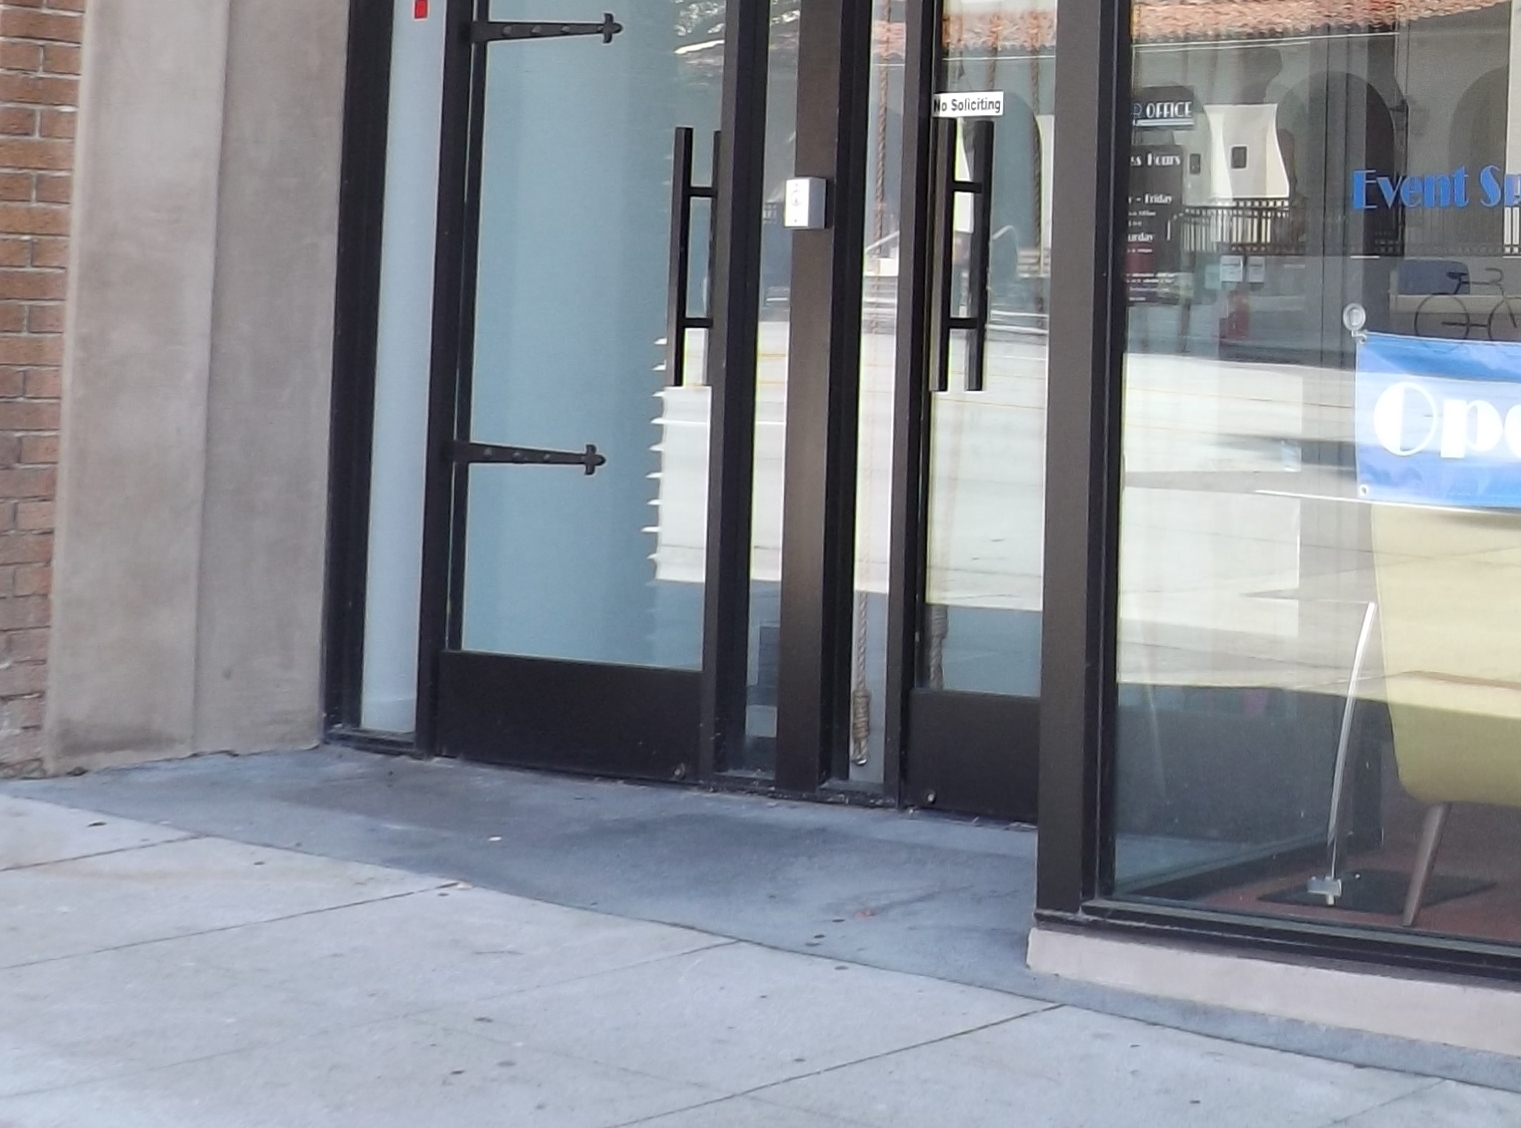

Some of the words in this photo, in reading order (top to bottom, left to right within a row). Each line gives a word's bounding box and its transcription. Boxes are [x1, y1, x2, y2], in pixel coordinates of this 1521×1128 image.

[933, 98, 948, 112] No
[951, 97, 1001, 113] Soliciting
[1146, 101, 1192, 119] OFFICE
[1352, 165, 1470, 210] Event
